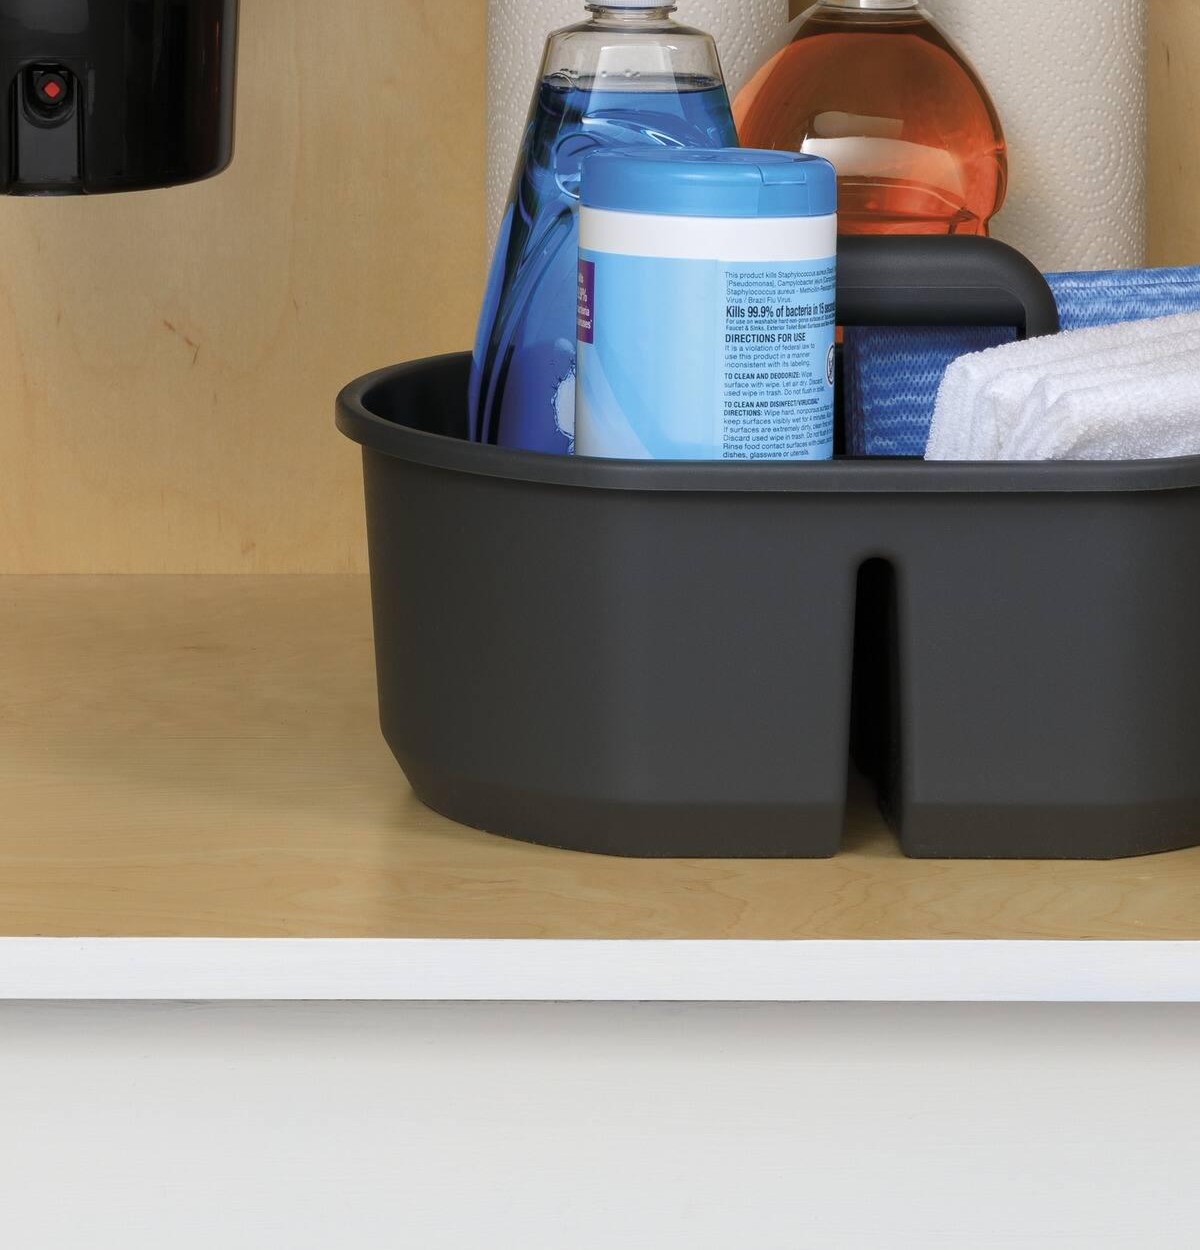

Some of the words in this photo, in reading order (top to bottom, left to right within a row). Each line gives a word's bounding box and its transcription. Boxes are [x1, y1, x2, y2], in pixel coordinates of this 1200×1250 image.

[726, 305, 745, 317] Kills
[748, 306, 774, 317] 99.9%
[776, 306, 784, 317] of
[786, 305, 811, 317] bacteria
[813, 305, 818, 315] in
[725, 334, 775, 343] DIRECTIONS
[778, 333, 791, 342] FOR
[794, 333, 805, 341] USE
[754, 353, 779, 361] product
[742, 390, 757, 398] wipe
[764, 409, 780, 417] Wipe
[772, 417, 791, 425] visibly
[750, 451, 782, 459] glassware
